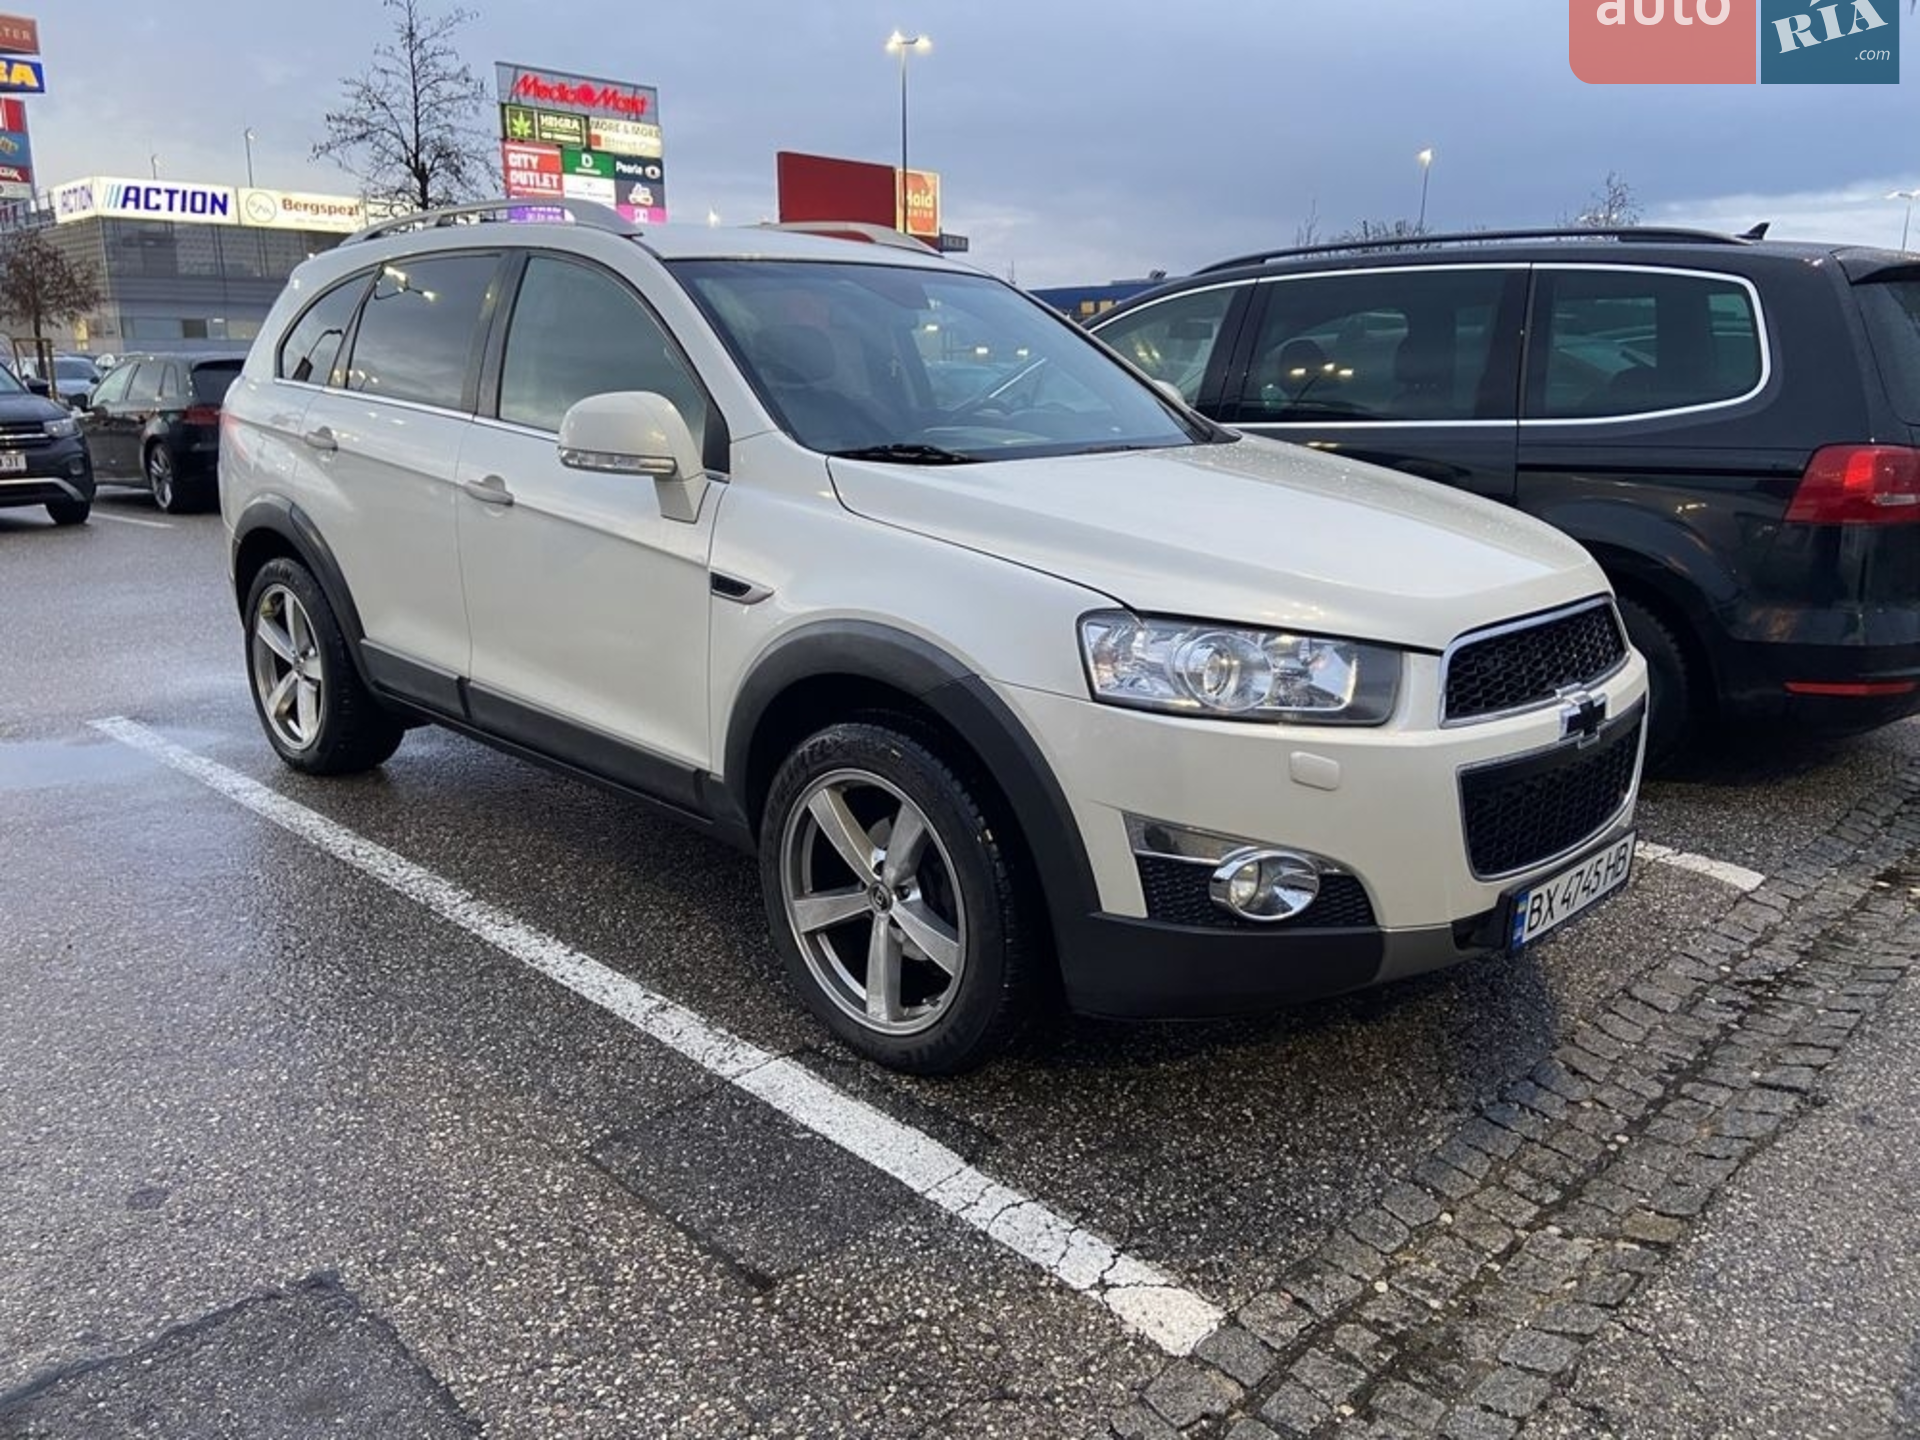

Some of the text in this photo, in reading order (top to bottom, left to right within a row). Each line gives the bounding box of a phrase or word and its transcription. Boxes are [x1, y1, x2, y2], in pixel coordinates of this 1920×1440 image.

[508, 152, 539, 170] CITY
[509, 169, 560, 189] OUTLET
[121, 185, 228, 216] ACTION
[1527, 842, 1629, 933] BX 4745 HB
